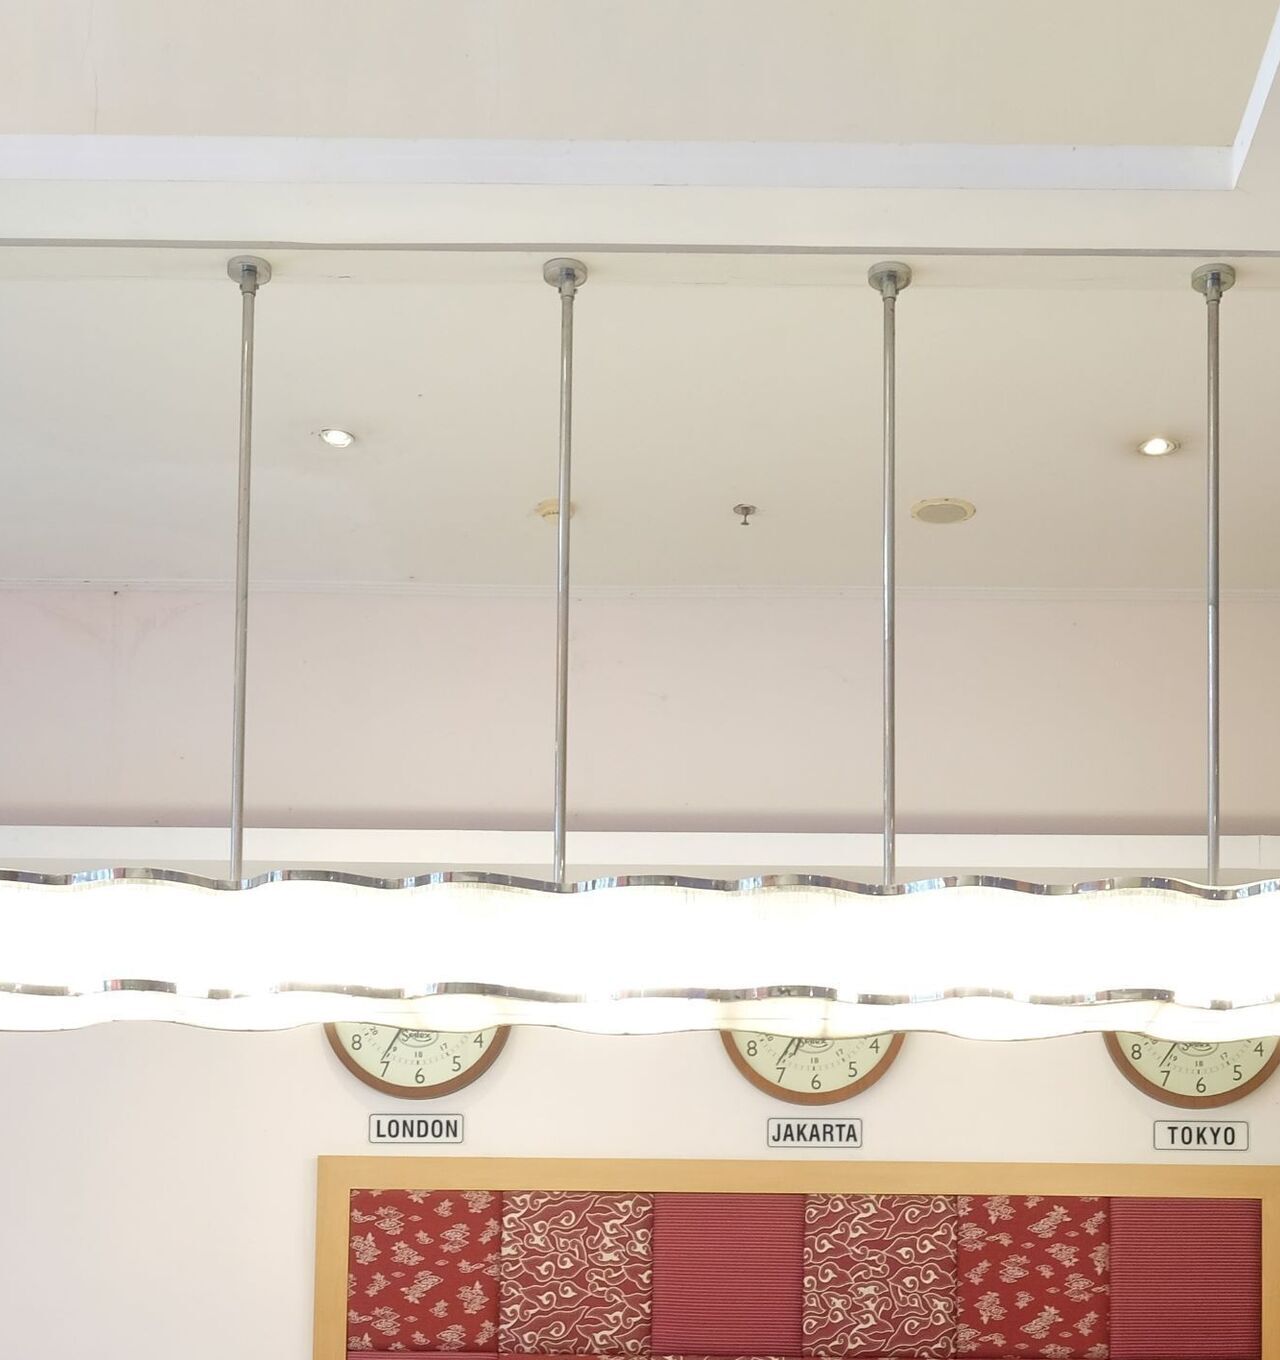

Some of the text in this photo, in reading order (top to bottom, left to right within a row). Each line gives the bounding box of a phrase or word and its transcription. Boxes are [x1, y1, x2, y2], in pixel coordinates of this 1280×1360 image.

[351, 1034, 362, 1050] 8
[473, 1032, 484, 1048] 4
[747, 1040, 758, 1057] 8
[869, 1038, 880, 1054] 4
[1131, 1043, 1142, 1060] 8
[1254, 1041, 1264, 1057] 4
[380, 1060, 390, 1077] 7
[452, 1055, 462, 1072] 5
[848, 1061, 858, 1078] 5
[414, 1067, 425, 1084] 6
[776, 1067, 786, 1083] 7
[811, 1073, 821, 1090] 6
[1160, 1070, 1170, 1087] 7
[1232, 1065, 1243, 1081] 5
[1196, 1077, 1207, 1093] 6
[376, 1119, 458, 1138] LONDON
[772, 1123, 858, 1142] JAKARTA
[1167, 1126, 1236, 1146] TOKYO
